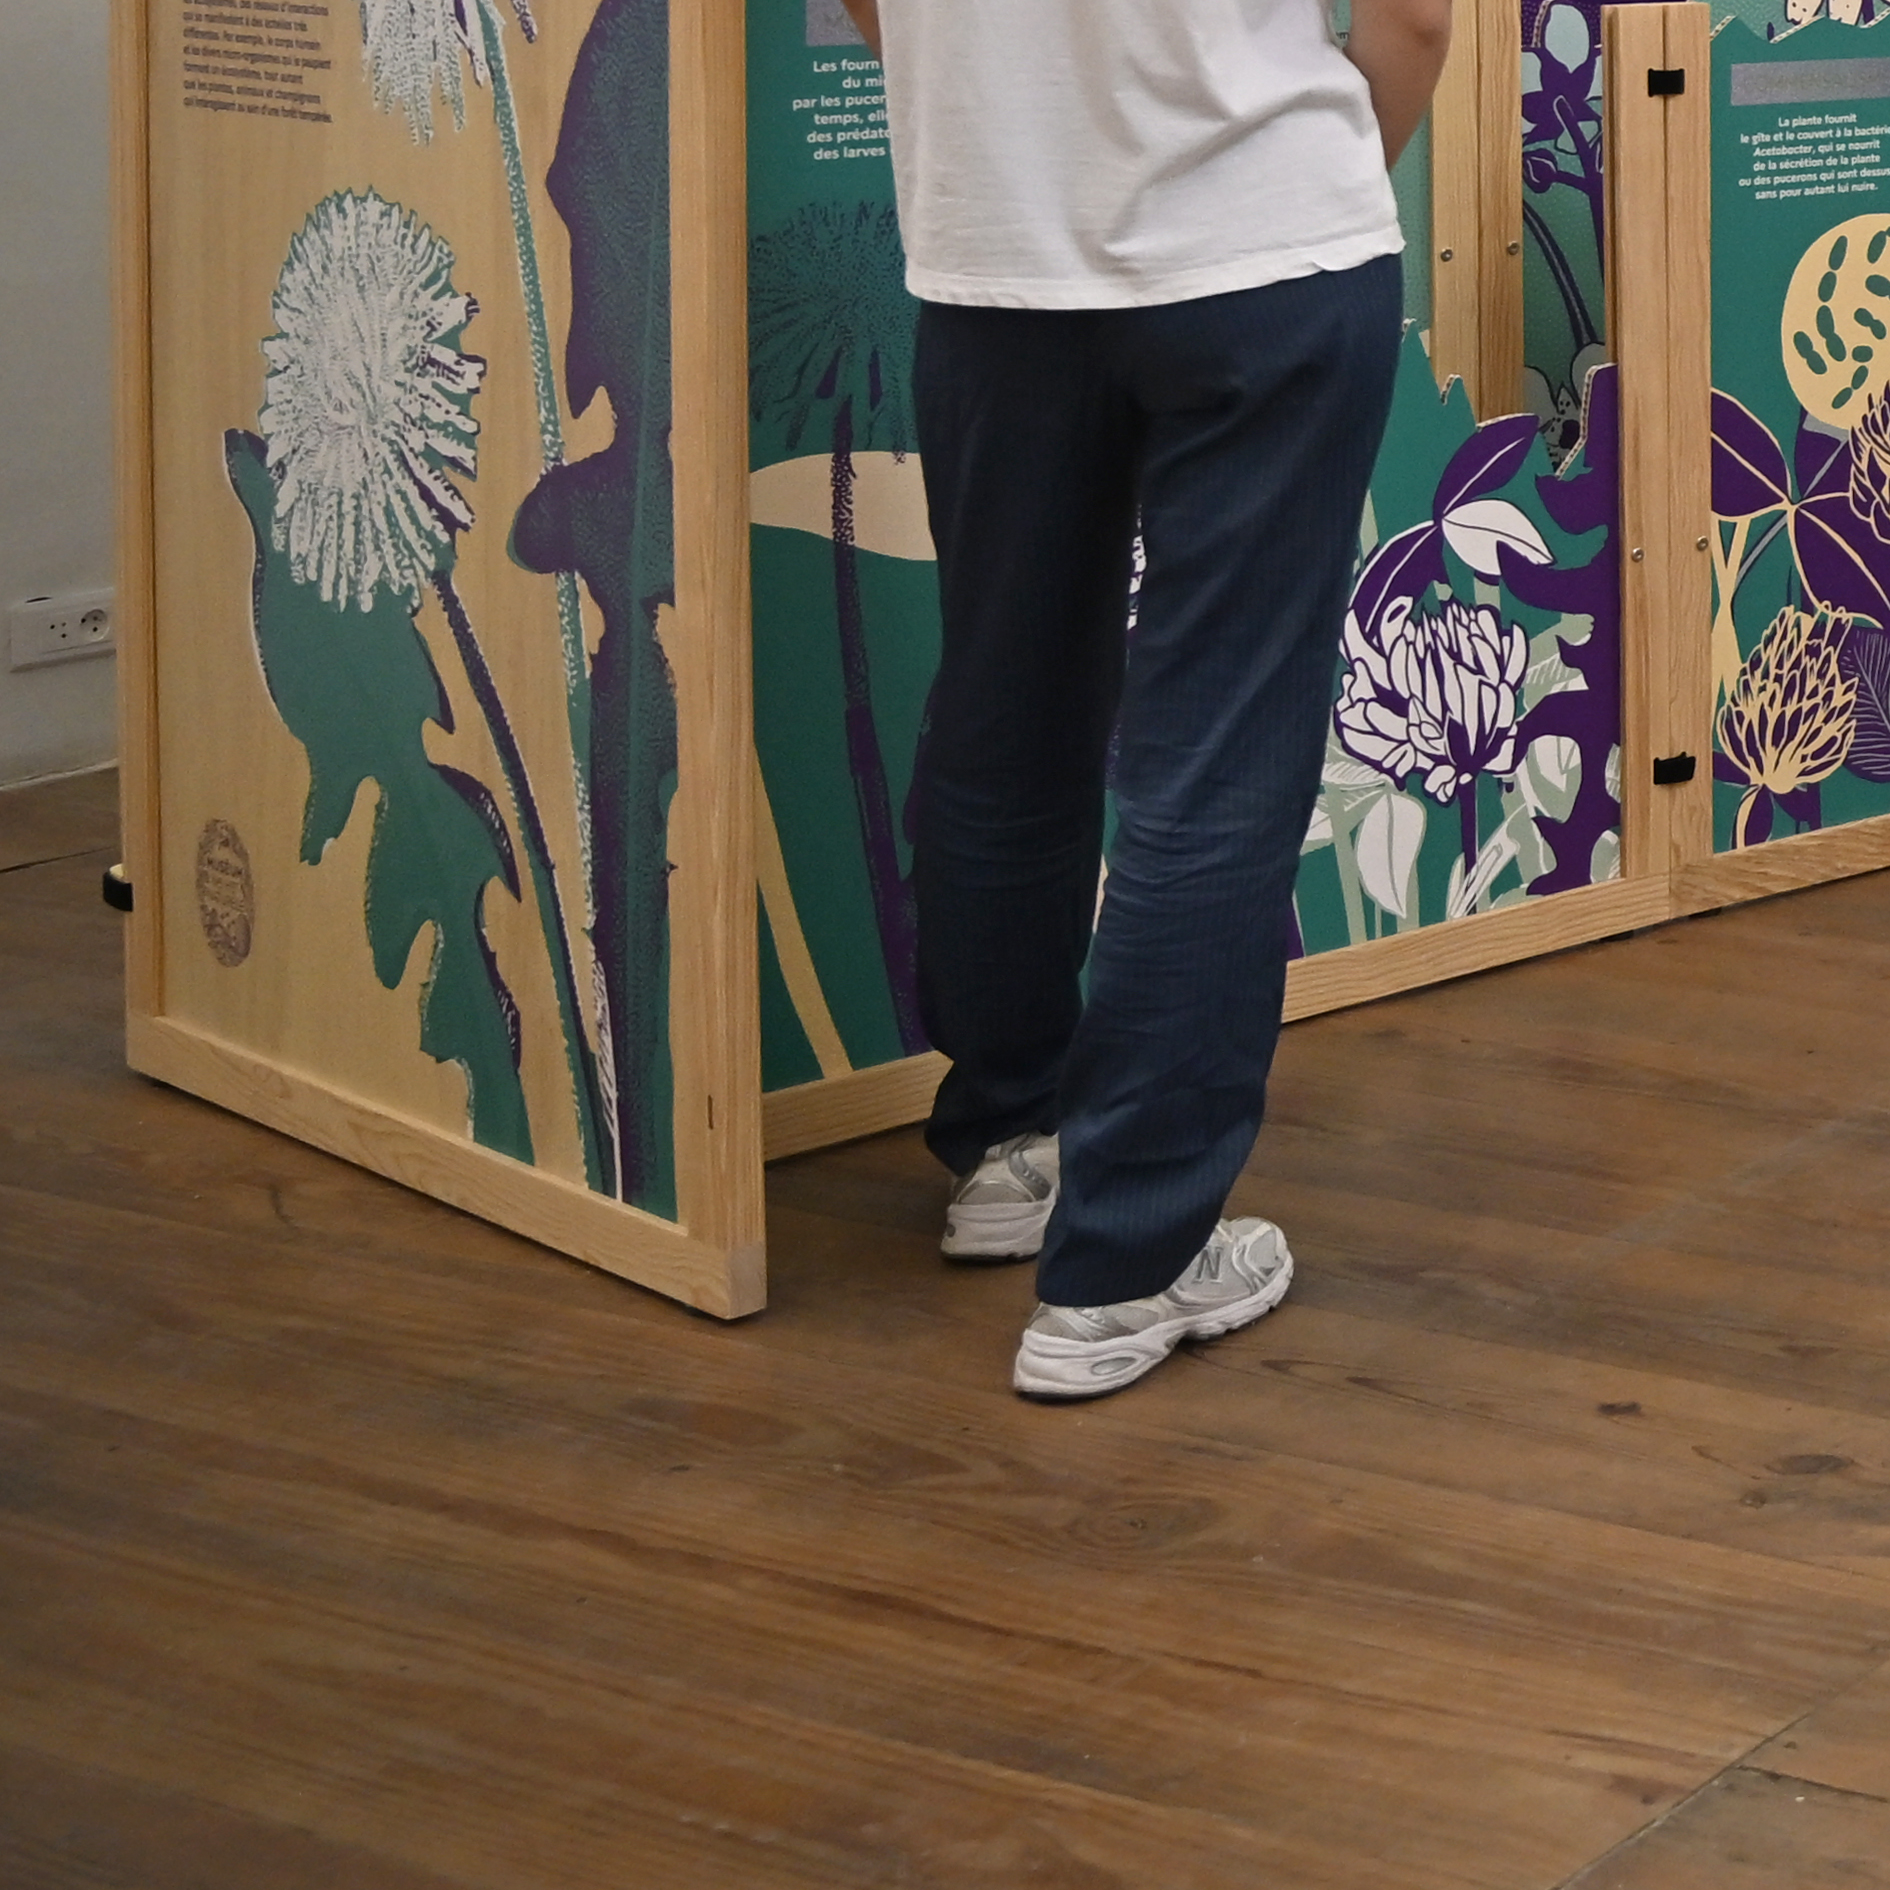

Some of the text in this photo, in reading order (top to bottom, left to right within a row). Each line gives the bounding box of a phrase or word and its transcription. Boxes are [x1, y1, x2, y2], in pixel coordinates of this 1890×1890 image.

[813, 61, 837, 72] Les
[793, 95, 841, 111] par les
[814, 113, 864, 126] temps,
[807, 131, 833, 143] des
[813, 146, 886, 160] des larves
